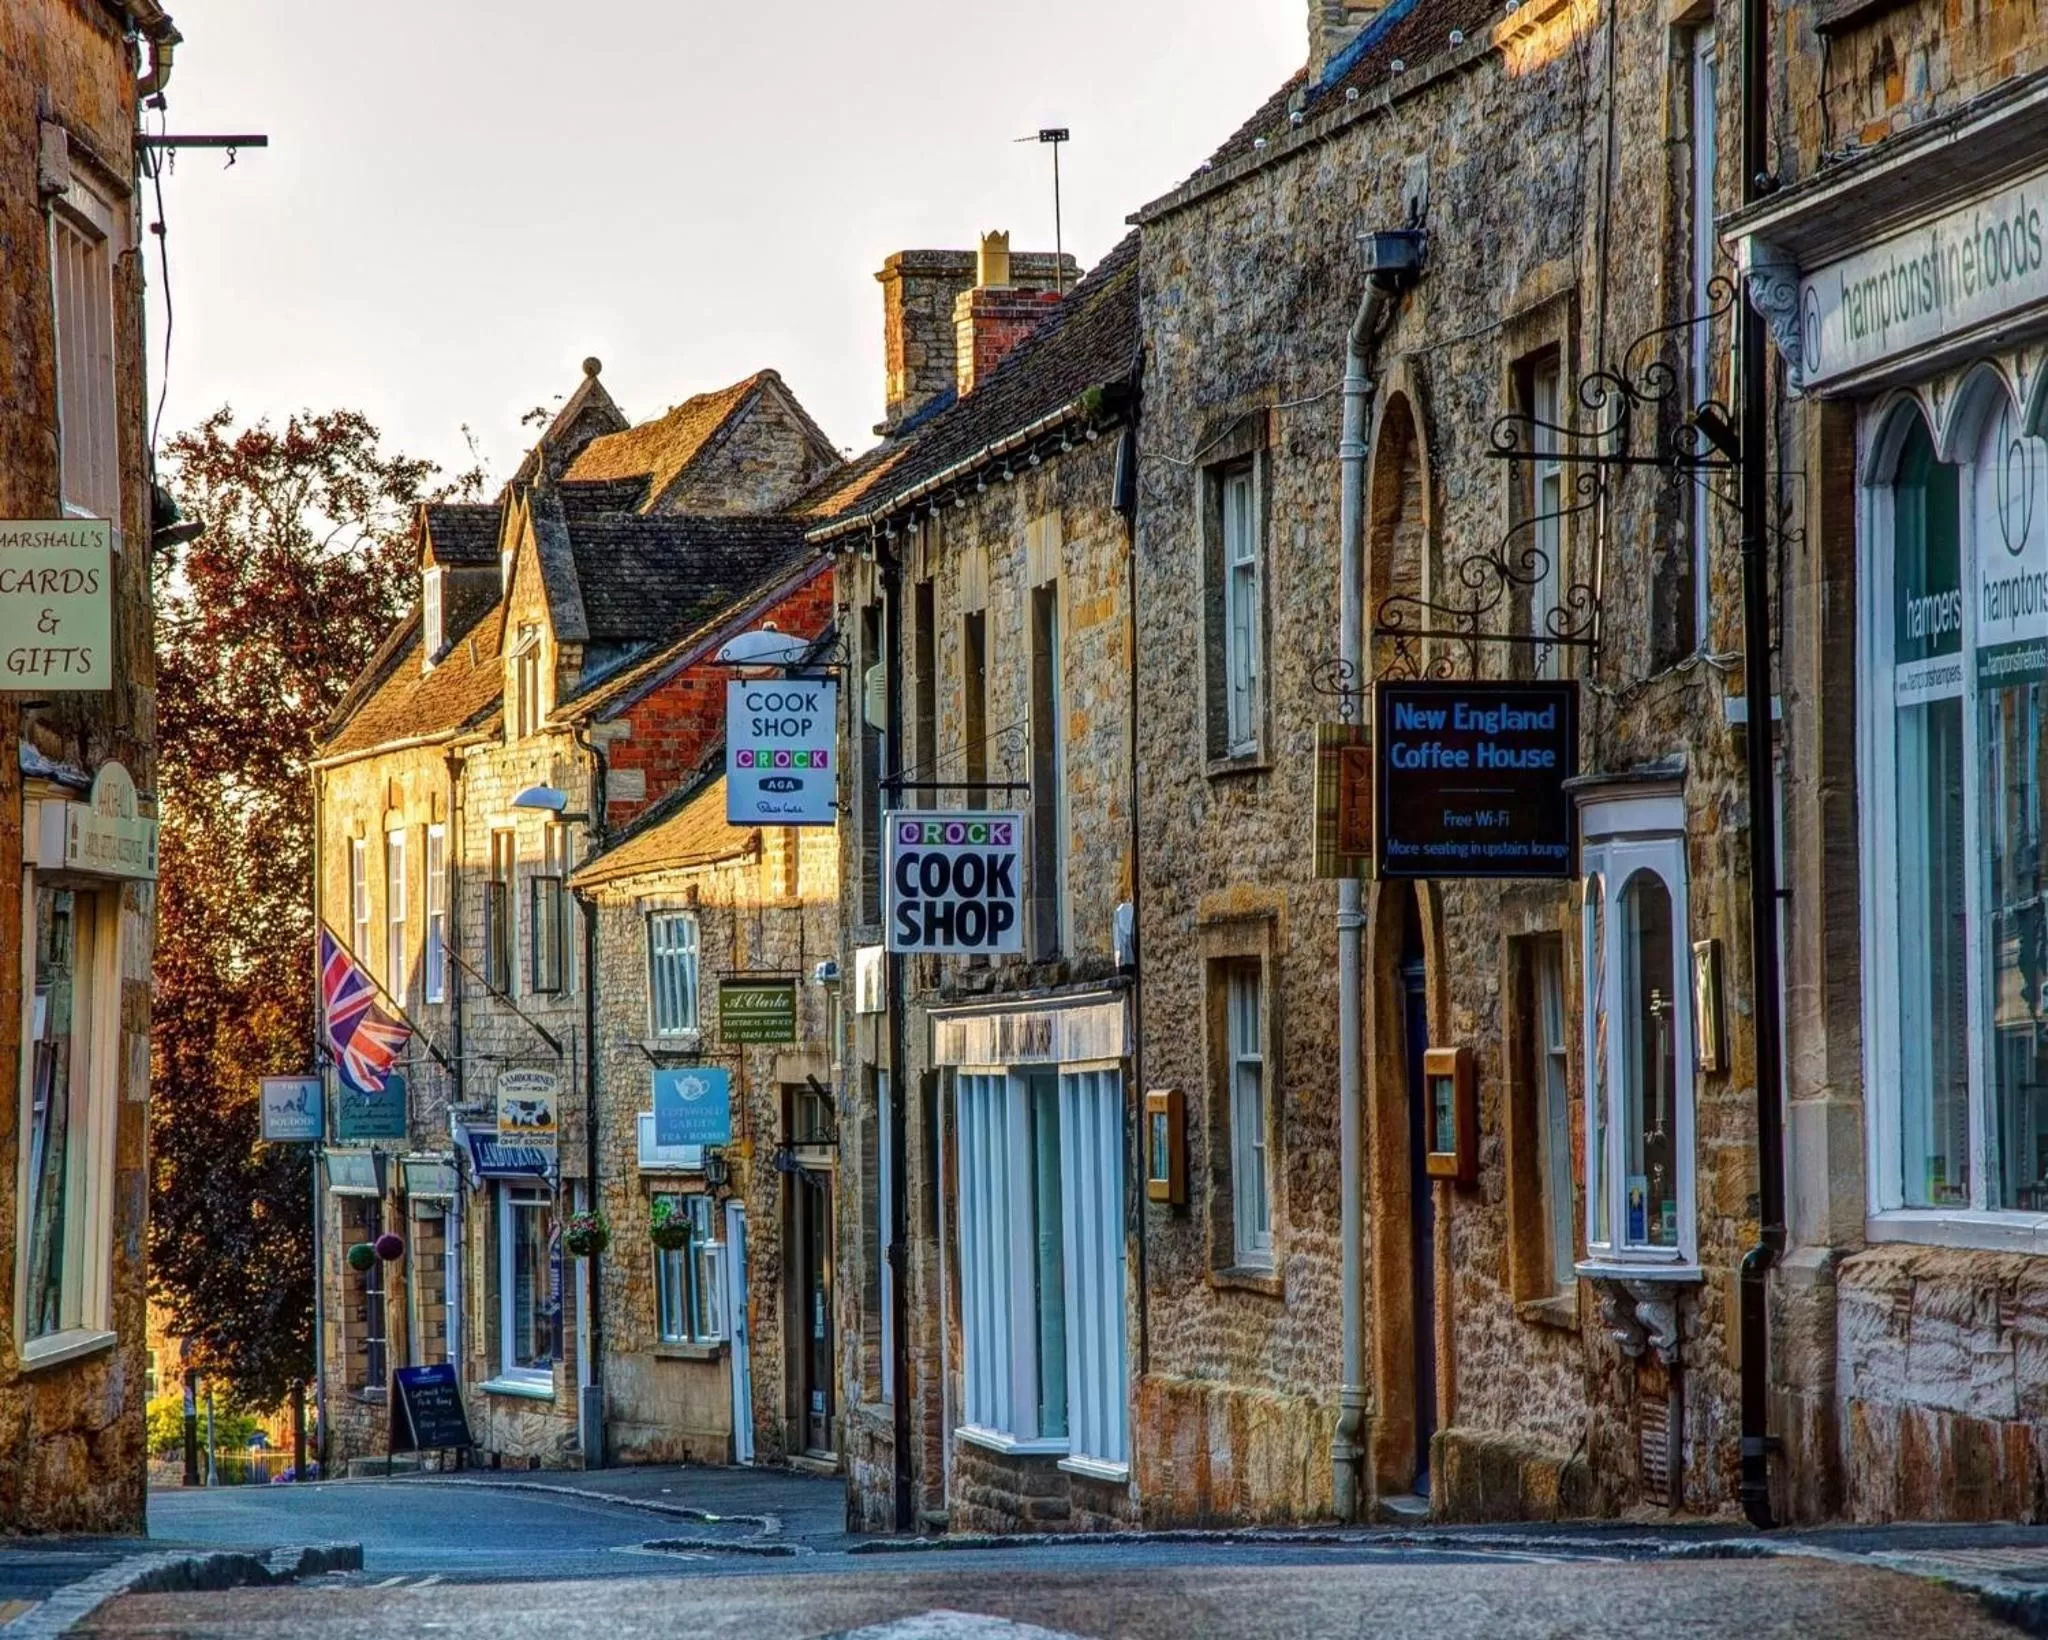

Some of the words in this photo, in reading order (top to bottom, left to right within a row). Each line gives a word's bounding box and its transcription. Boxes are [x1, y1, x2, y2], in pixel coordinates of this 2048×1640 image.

[0, 568, 99, 595] CARDS
[1983, 565, 2048, 634] hamptons
[37, 608, 60, 635] &
[1906, 588, 1961, 648] hampers
[6, 648, 92, 676] GIFTS
[746, 693, 818, 712] COOK
[752, 718, 813, 737] SHOP
[1395, 703, 1447, 730] New
[1454, 703, 1556, 734] England
[737, 750, 827, 768] CROCK
[1391, 743, 1470, 769] Coffee
[1477, 743, 1556, 769] House
[767, 780, 795, 790] AGA
[1443, 810, 1472, 827] Free
[1475, 810, 1510, 827] Wi-Fi
[900, 823, 1011, 844] CROCK
[1387, 840, 1420, 855] More
[1423, 841, 1469, 858] seating
[1471, 841, 1482, 855] in
[1483, 841, 1529, 857] upstairs
[1531, 840, 1570, 858] lounge
[895, 852, 1017, 898] COOK
[896, 900, 1015, 947] SHOP
[744, 993, 790, 1008] Clarke
